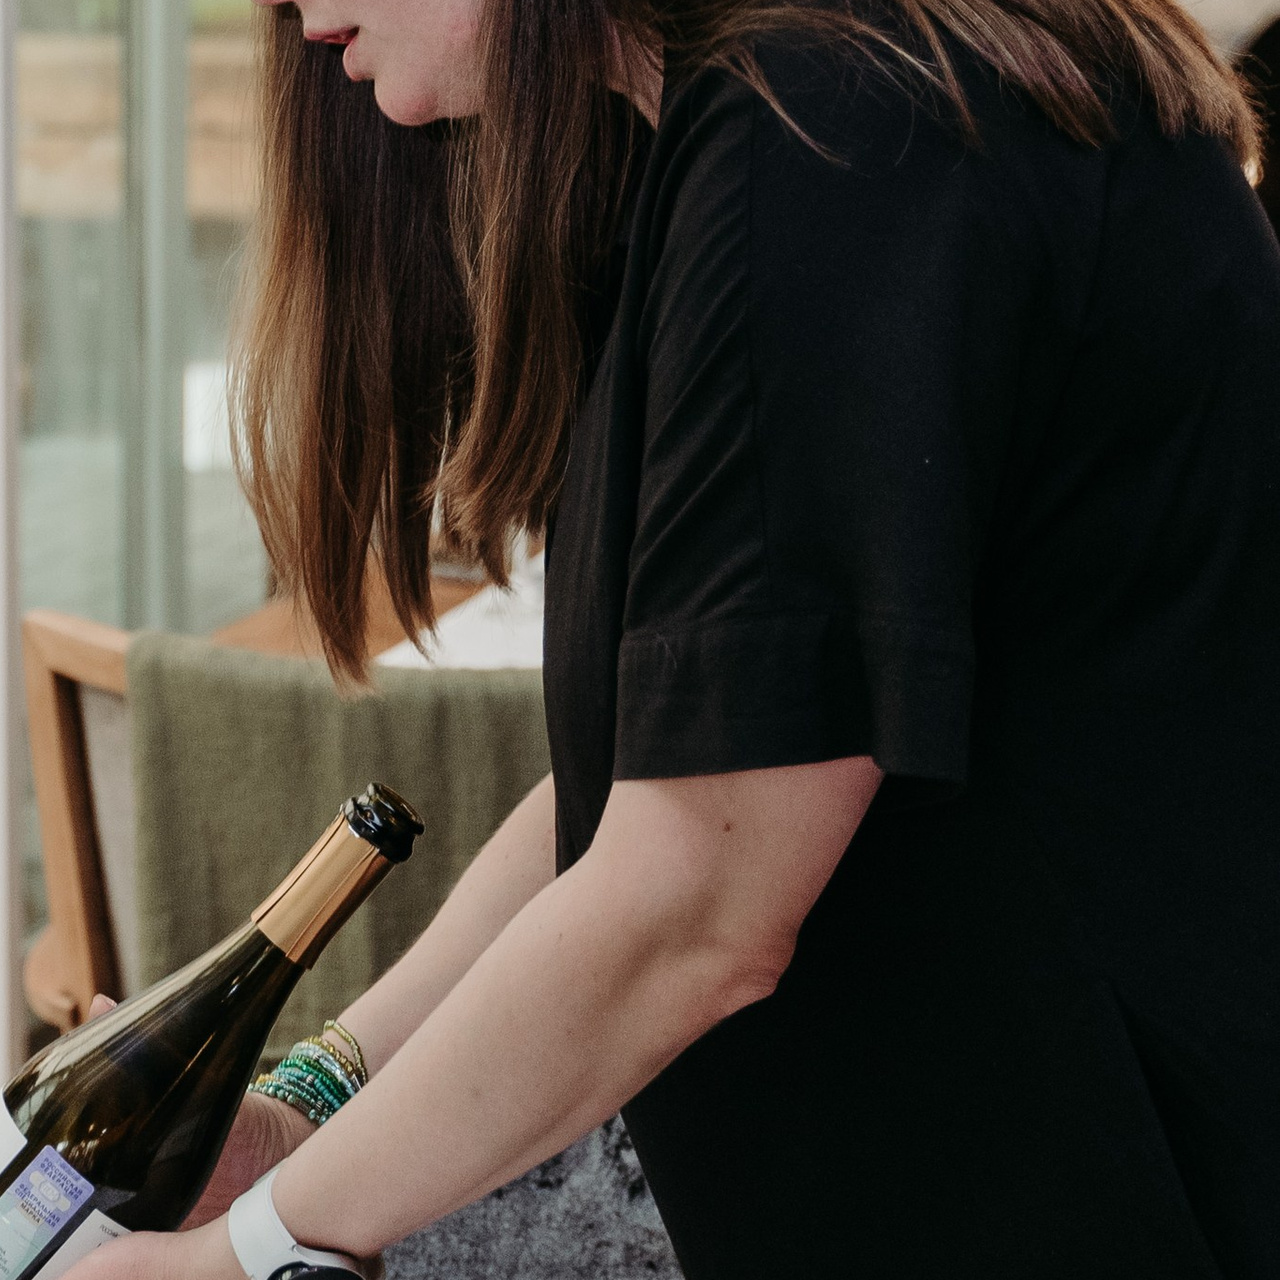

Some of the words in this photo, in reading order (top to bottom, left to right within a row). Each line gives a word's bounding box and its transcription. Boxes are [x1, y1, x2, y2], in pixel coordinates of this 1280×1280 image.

[40, 1162, 79, 1200] ФЕДЕРАЦИЯ
[43, 1157, 83, 1196] РОССИЙСКАЯ
[14, 1187, 56, 1228] СПЕЦИАЛЬНАЯ
[19, 1183, 61, 1223] ФЕДЕРАЛЬНАЯ
[20, 1202, 41, 1224] МАРКА
